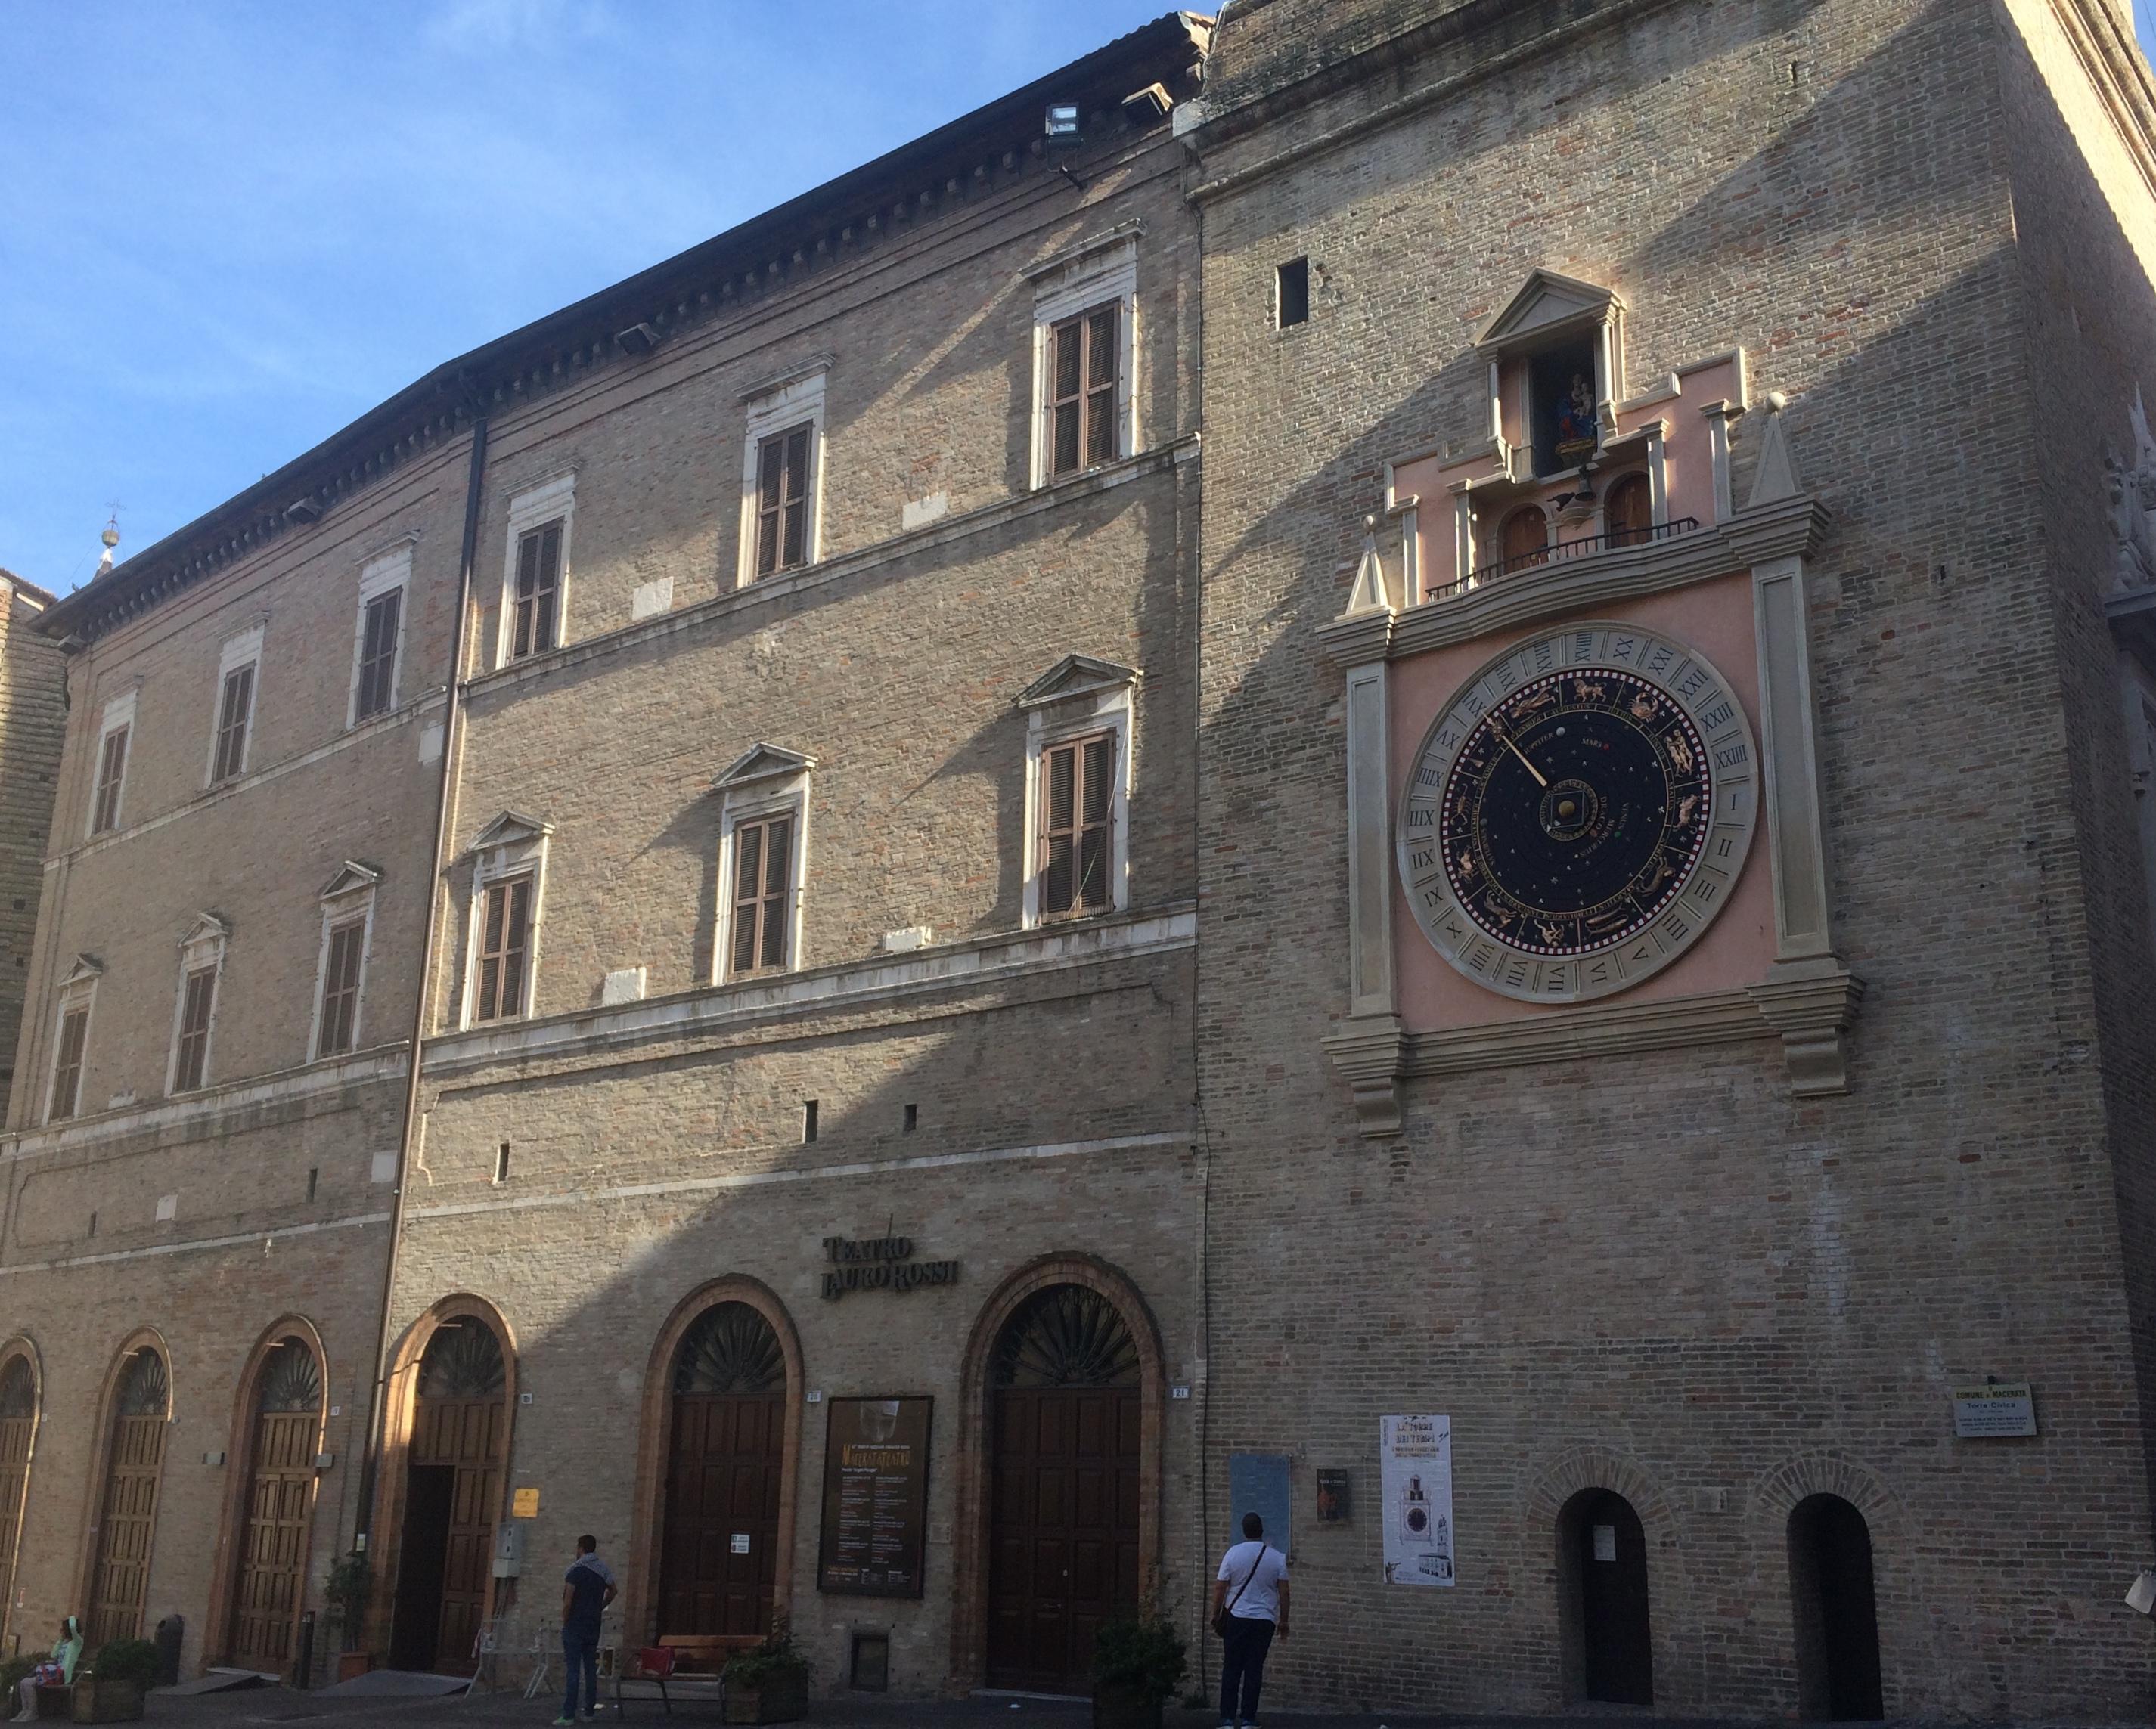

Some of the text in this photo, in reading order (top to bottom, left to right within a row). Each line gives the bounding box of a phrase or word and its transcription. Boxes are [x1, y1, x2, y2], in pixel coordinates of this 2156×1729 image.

[1534, 640, 1553, 673] XVIII
[1574, 632, 1592, 662] XVIIII
[1613, 637, 1633, 660] XX
[1648, 647, 1674, 675] XXI
[1494, 662, 1519, 691] XVII
[1677, 669, 1708, 700] XXII
[1461, 691, 1486, 718] XVI
[1699, 702, 1734, 732] XXIII
[1436, 730, 1460, 750] XV
[1523, 732, 1556, 755] IUPPITER
[1581, 737, 1602, 748] MARS
[1714, 745, 1748, 770] XXIIII
[1416, 767, 1444, 786] XIIII
[1409, 810, 1435, 826] XIII
[1596, 796, 1608, 830] DRACO
[1618, 802, 1630, 829] VENUS
[1413, 849, 1435, 869] XII
[1717, 839, 1733, 857] II
[1425, 887, 1444, 907] XI
[1694, 880, 1716, 901] III
[1446, 922, 1462, 938] X
[1662, 914, 1689, 941] IIII
[1470, 943, 1495, 971] VIIII
[1632, 946, 1649, 961] V
[1506, 961, 1528, 987] VIII
[1548, 966, 1565, 991] VII
[1590, 962, 1607, 984] VI
[822, 1236, 912, 1261] TEATRO
[821, 1260, 958, 1300] LAURO ROSSI
[1992, 1390, 2026, 1399] MACERATA
